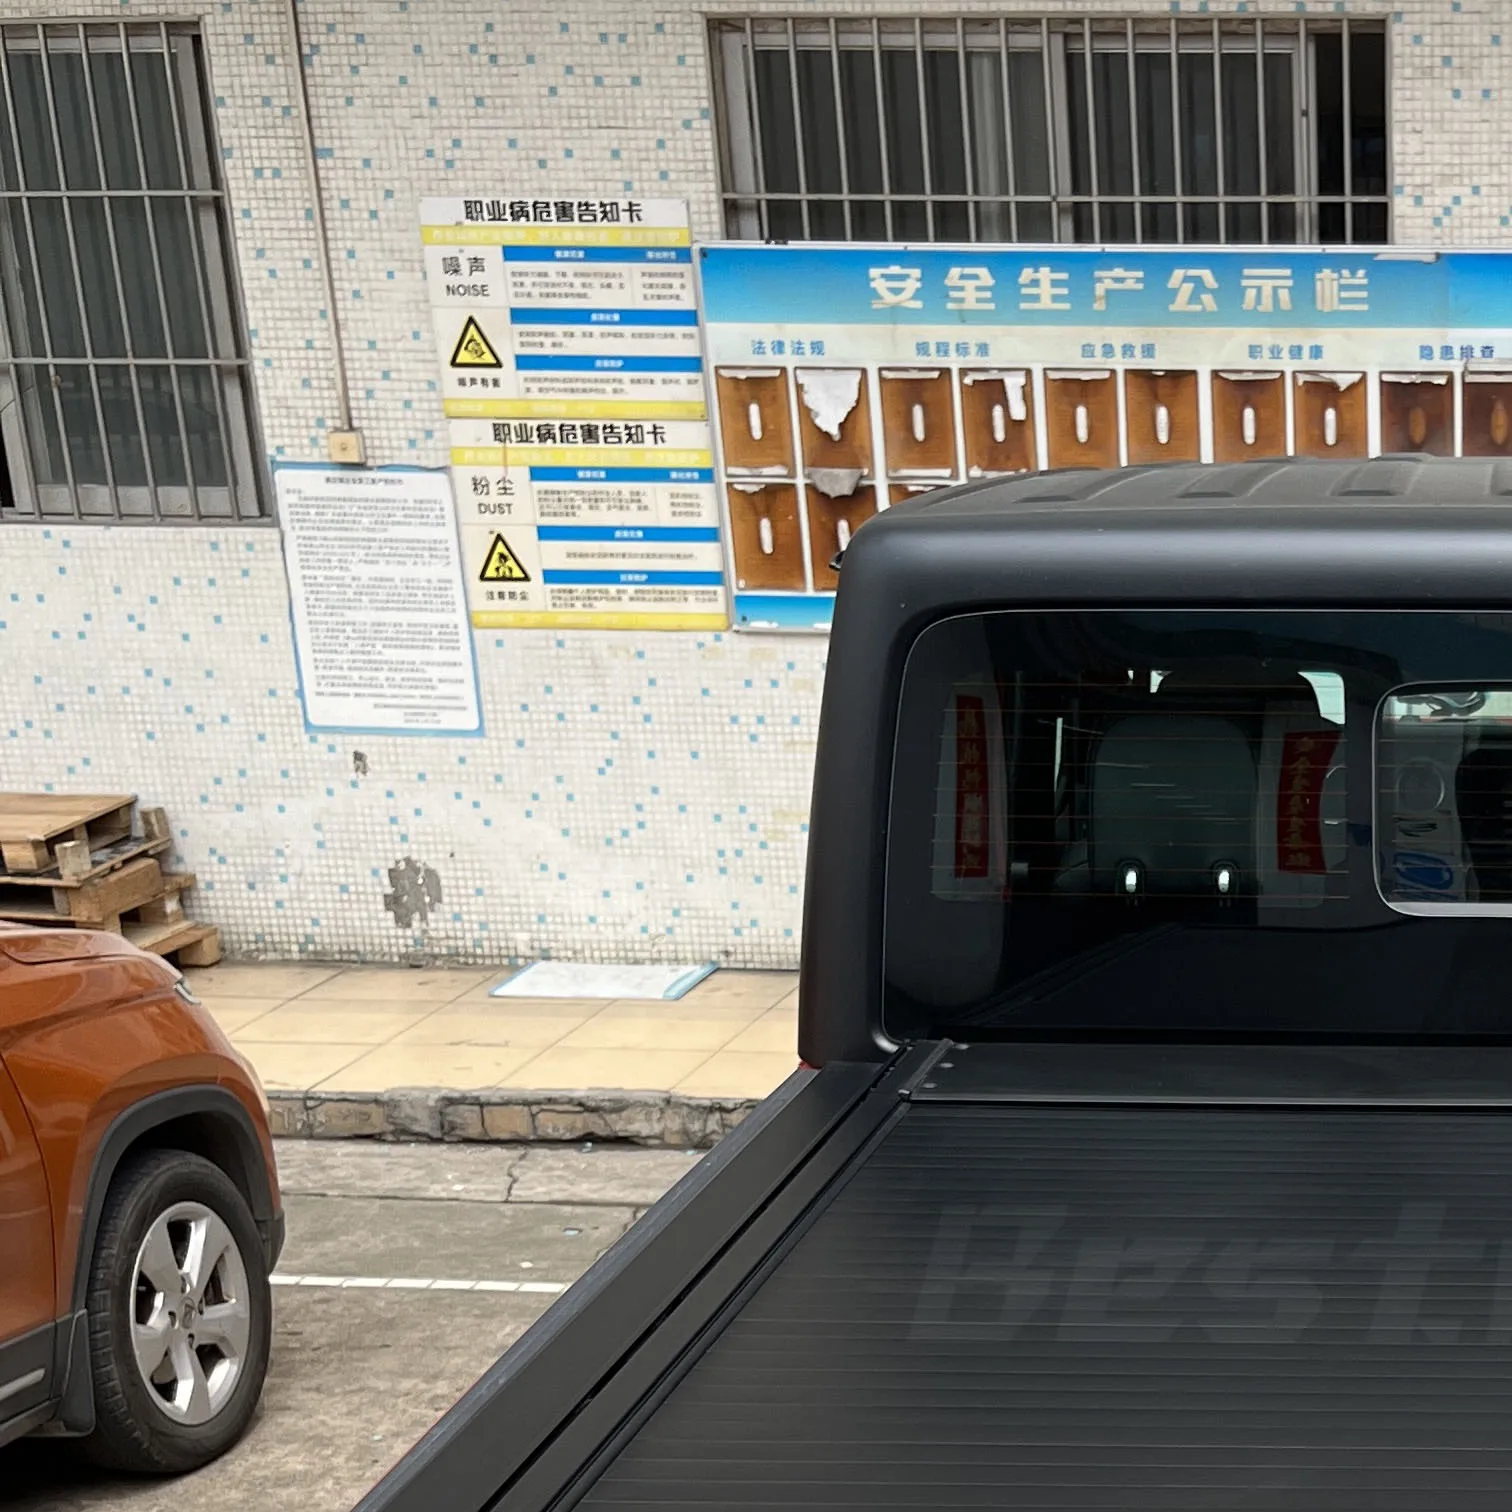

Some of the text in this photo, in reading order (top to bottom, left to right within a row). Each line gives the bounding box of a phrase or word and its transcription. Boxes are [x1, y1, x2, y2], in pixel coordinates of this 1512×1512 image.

[463, 199, 644, 224] 职业病危害告知卡
[446, 283, 491, 298] NOISE
[867, 264, 1371, 313] 安全生产公示栏
[492, 422, 668, 446] 职业病危害告知卡
[477, 502, 513, 516] DUST
